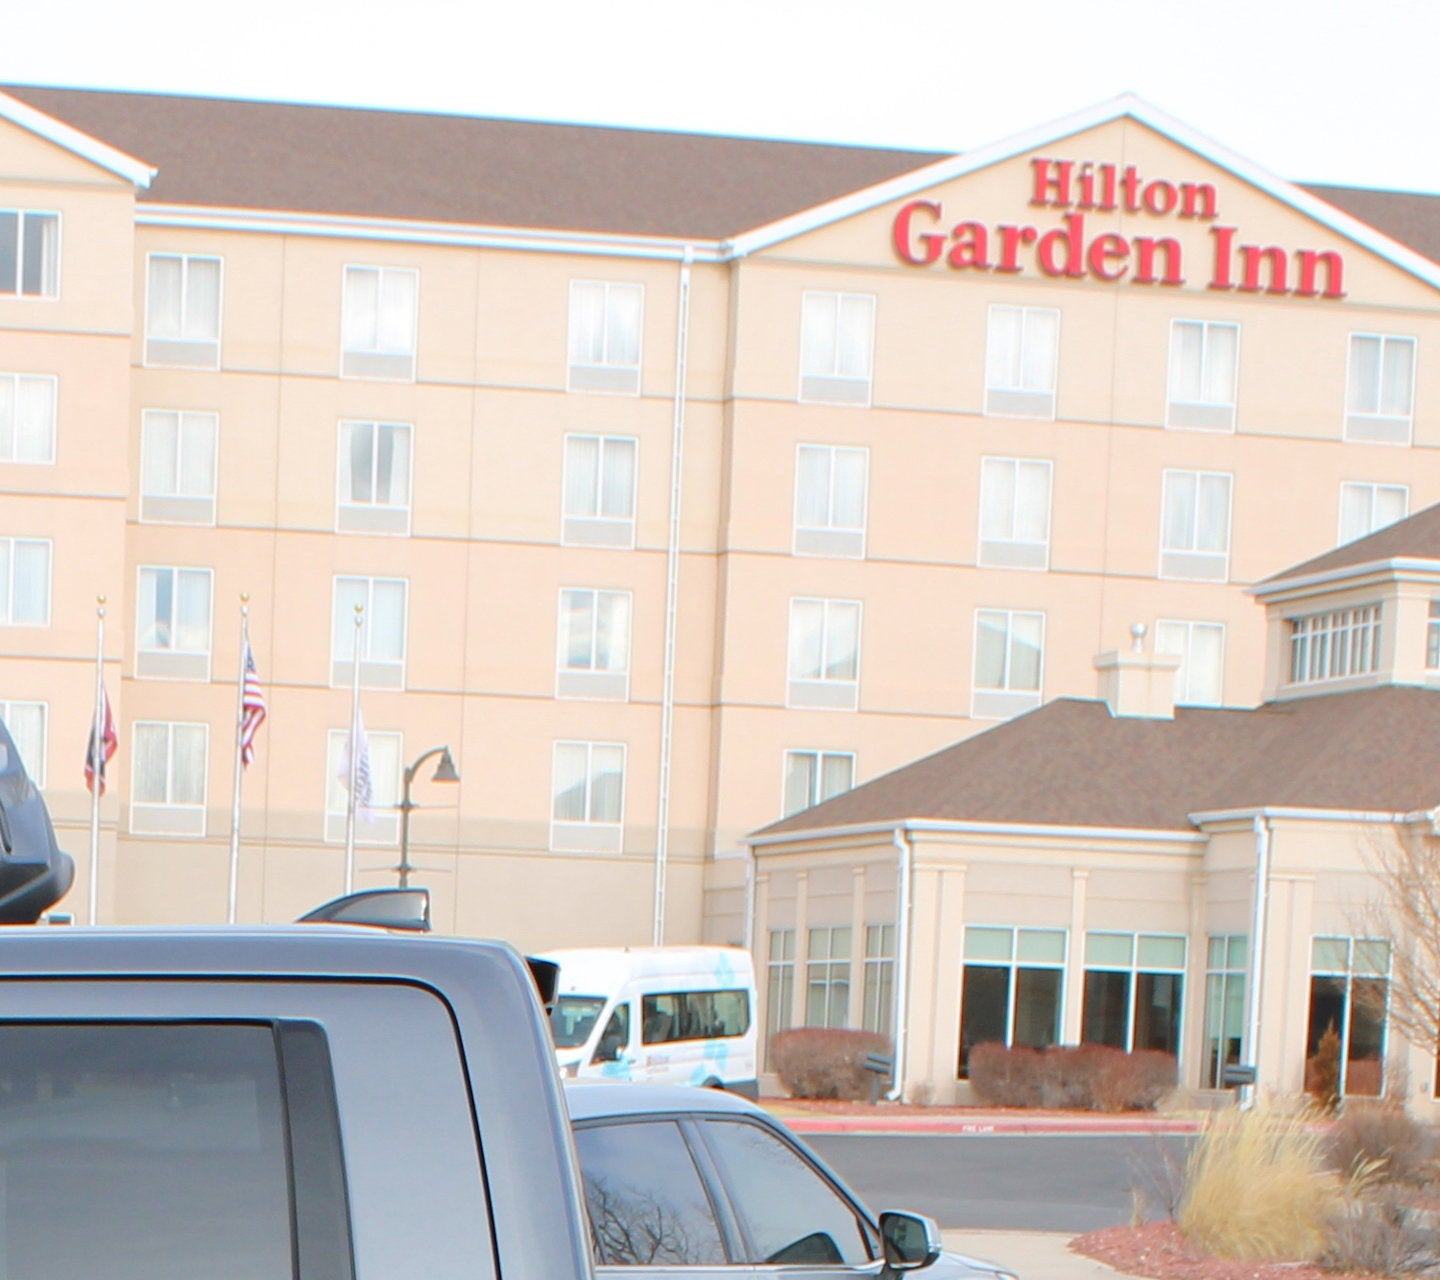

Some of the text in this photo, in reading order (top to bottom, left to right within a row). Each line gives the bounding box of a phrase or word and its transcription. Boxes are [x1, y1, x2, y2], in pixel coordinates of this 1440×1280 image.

[1029, 157, 1218, 219] Hilton
[892, 200, 1347, 300] Garden Inn
